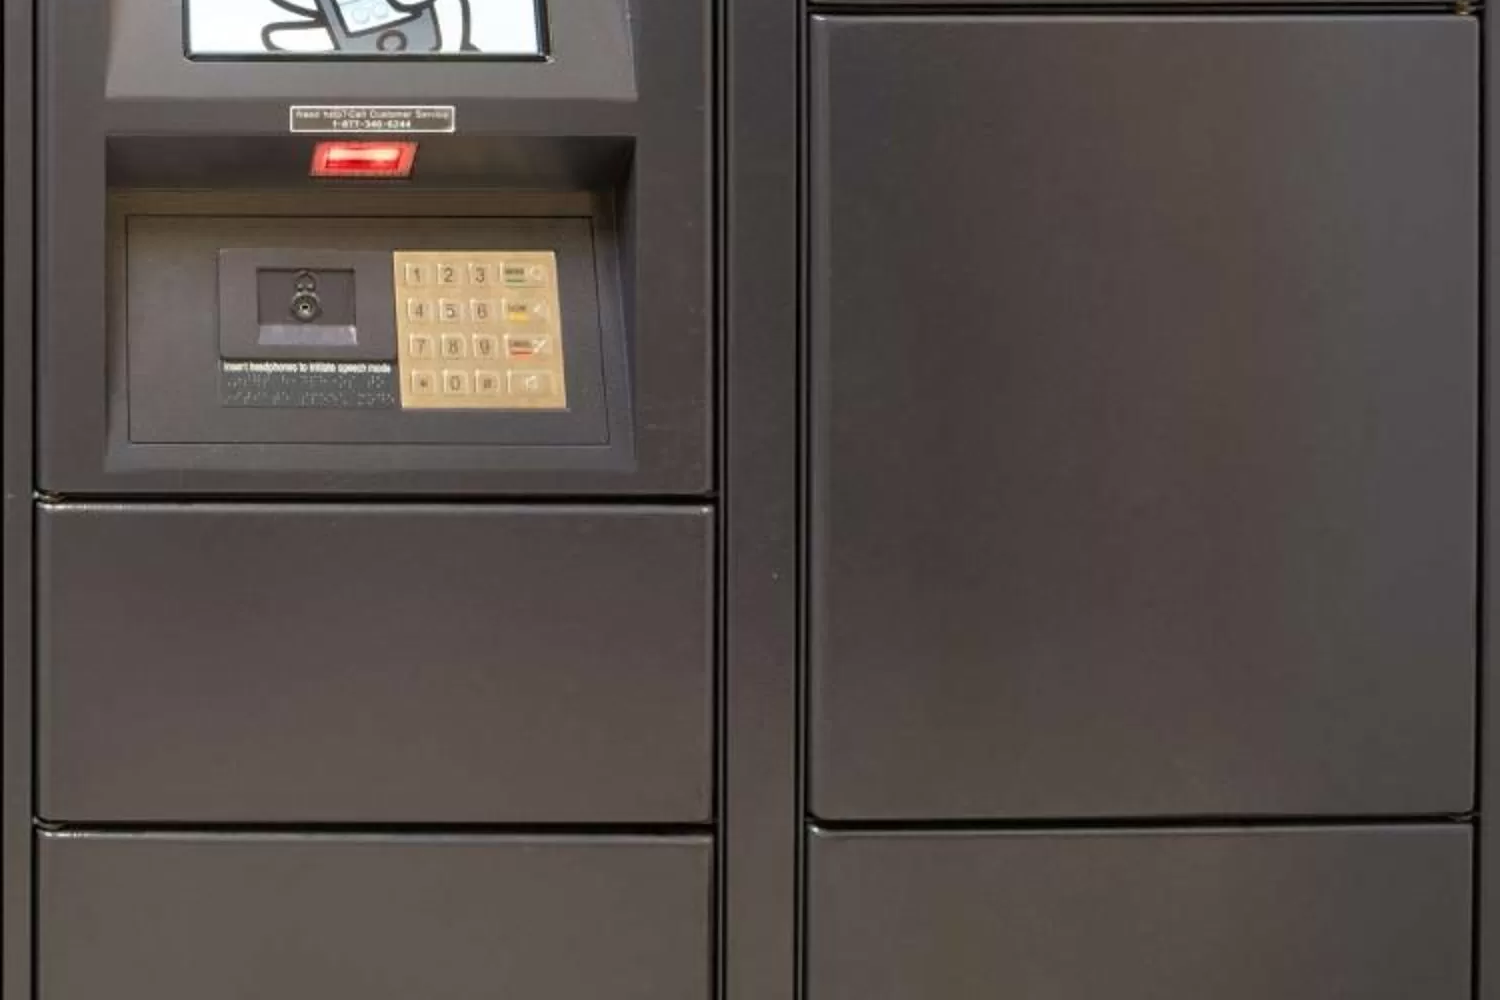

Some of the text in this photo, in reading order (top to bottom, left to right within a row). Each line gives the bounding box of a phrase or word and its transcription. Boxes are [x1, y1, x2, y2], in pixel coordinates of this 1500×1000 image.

[369, 110, 412, 119] Customer
[415, 110, 449, 119] Service
[413, 267, 485, 283] 1 2 3
[414, 303, 488, 319] 4 5 6
[415, 339, 490, 354] 7 8 9
[249, 363, 298, 374] headphones
[299, 363, 309, 373] to
[309, 363, 336, 373] initiate
[337, 363, 367, 374] speech
[368, 363, 391, 373] mode
[451, 375, 461, 391] 0
